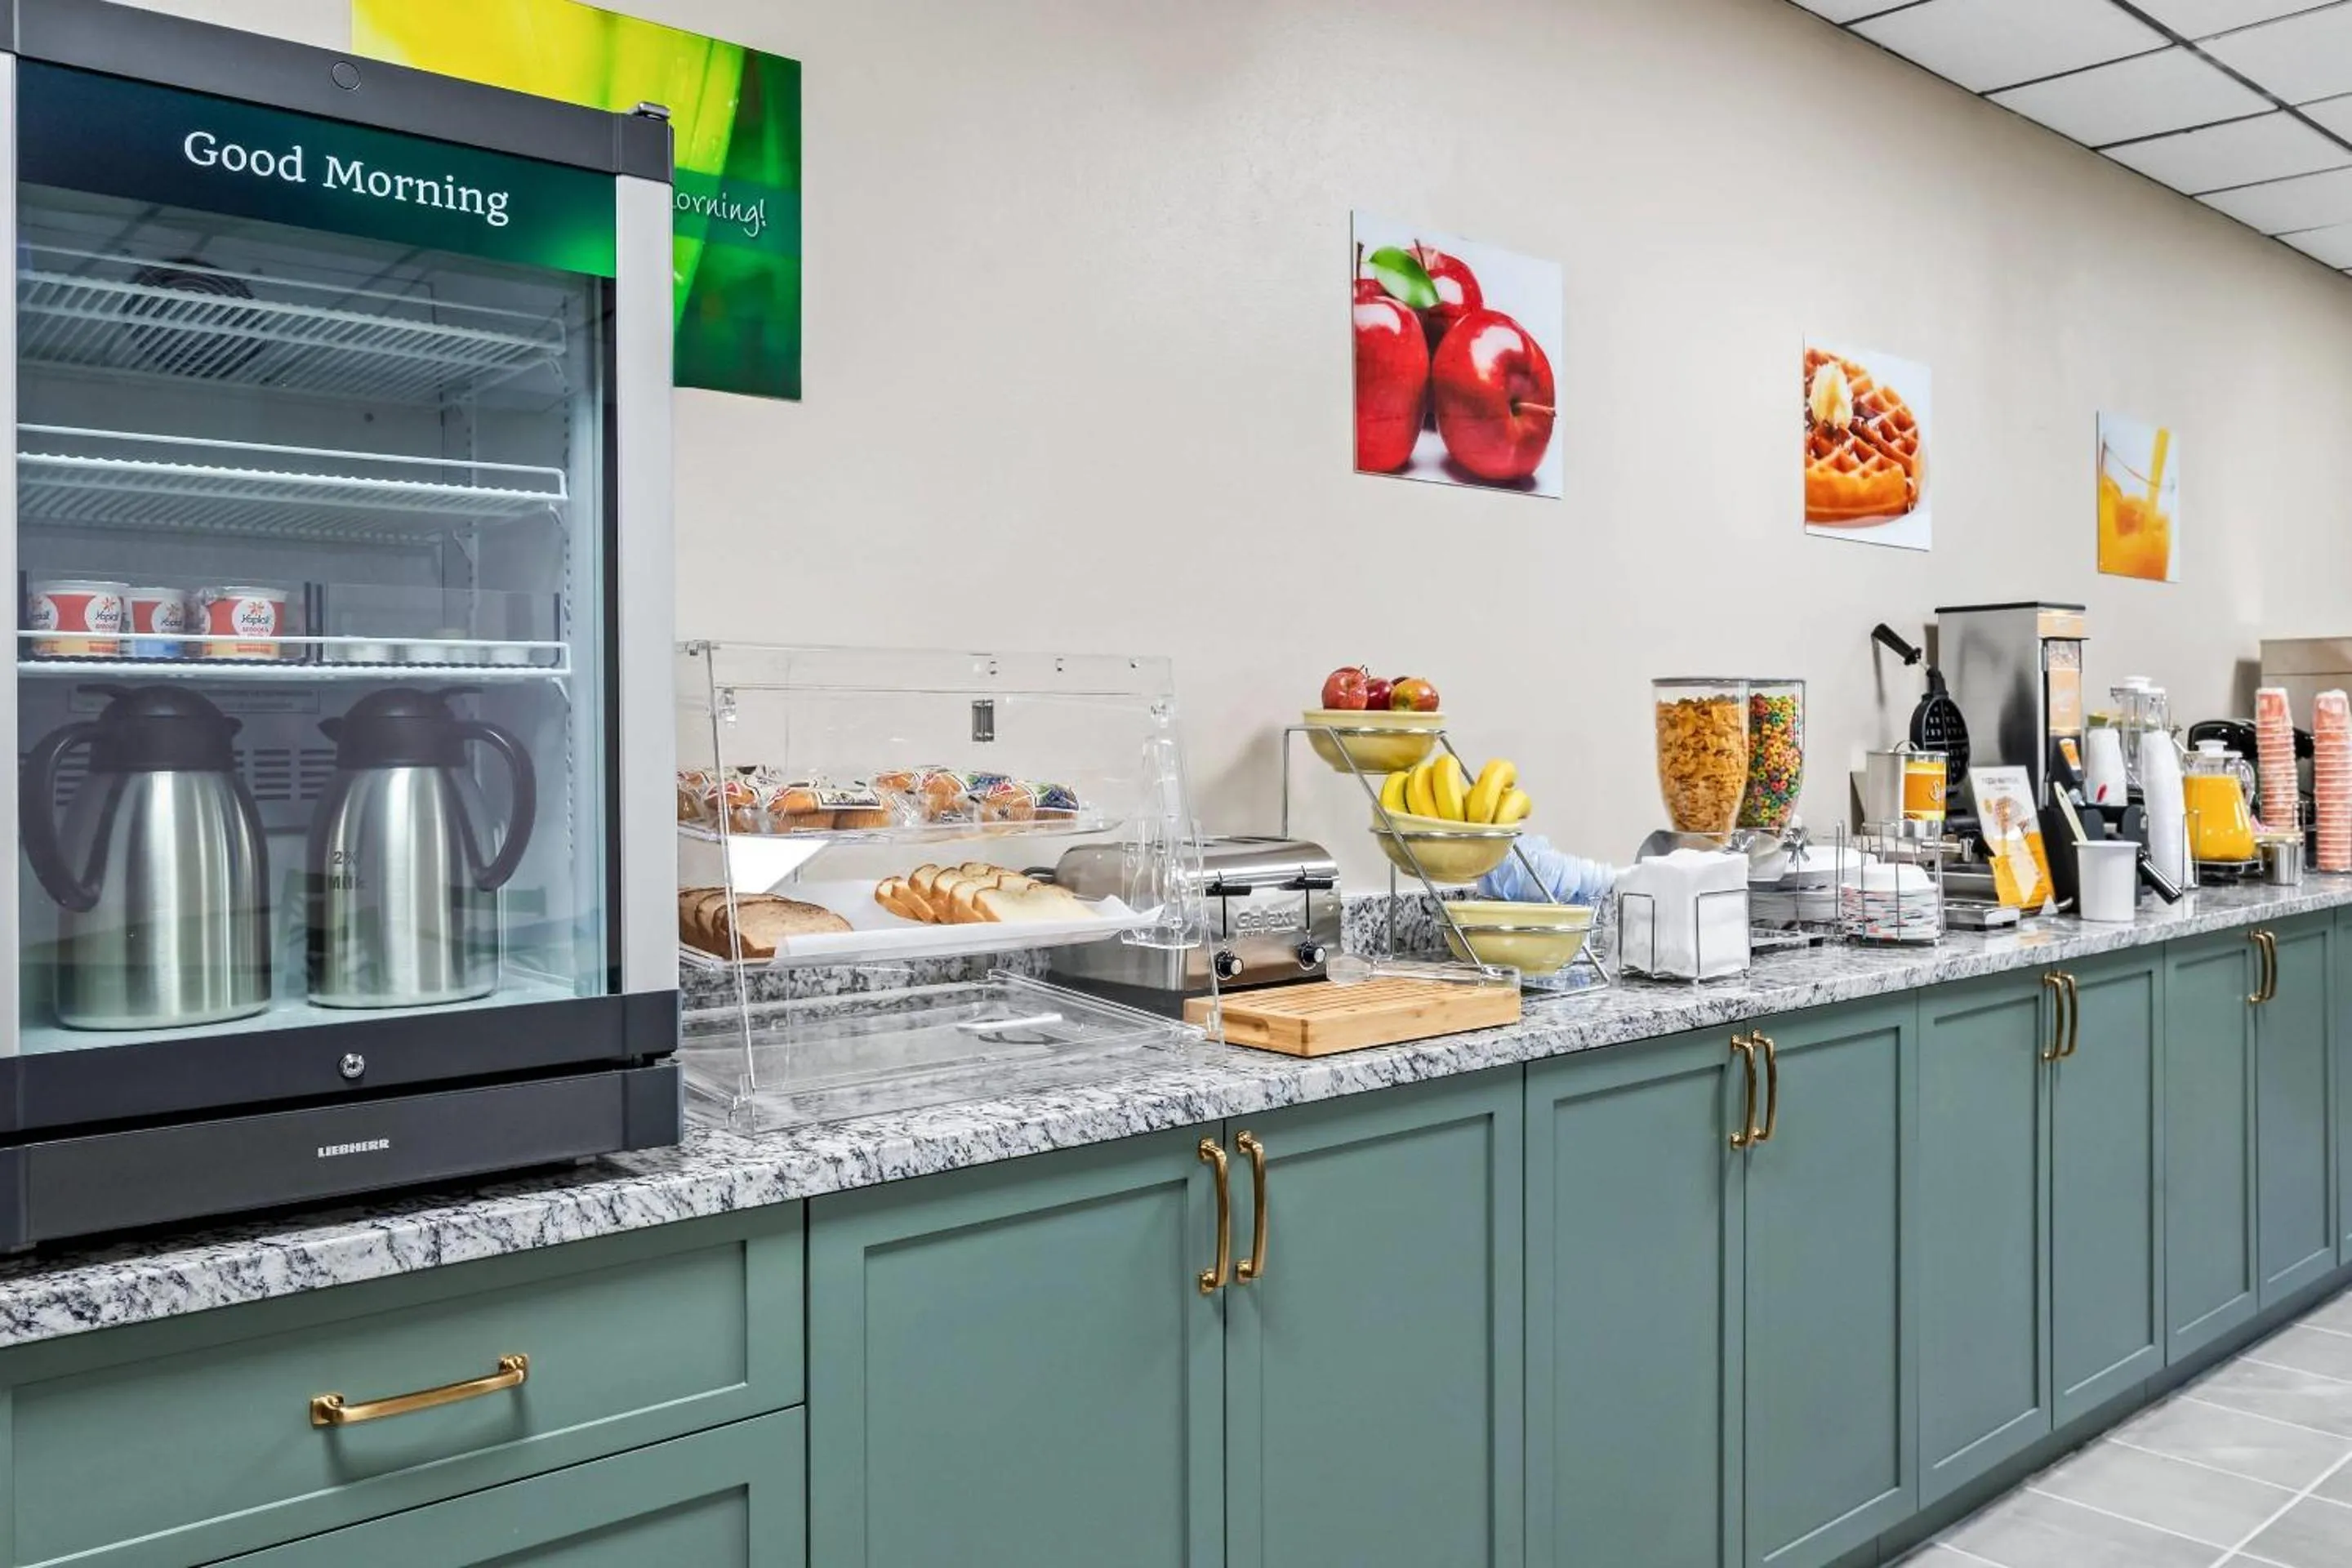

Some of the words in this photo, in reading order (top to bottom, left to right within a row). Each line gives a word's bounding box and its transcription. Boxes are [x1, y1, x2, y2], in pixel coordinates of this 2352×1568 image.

[185, 131, 306, 183] Good
[323, 155, 510, 226] Morning
[672, 192, 766, 237] orning!
[333, 851, 357, 865] 2%
[318, 1139, 390, 1158] LIEBHERR
